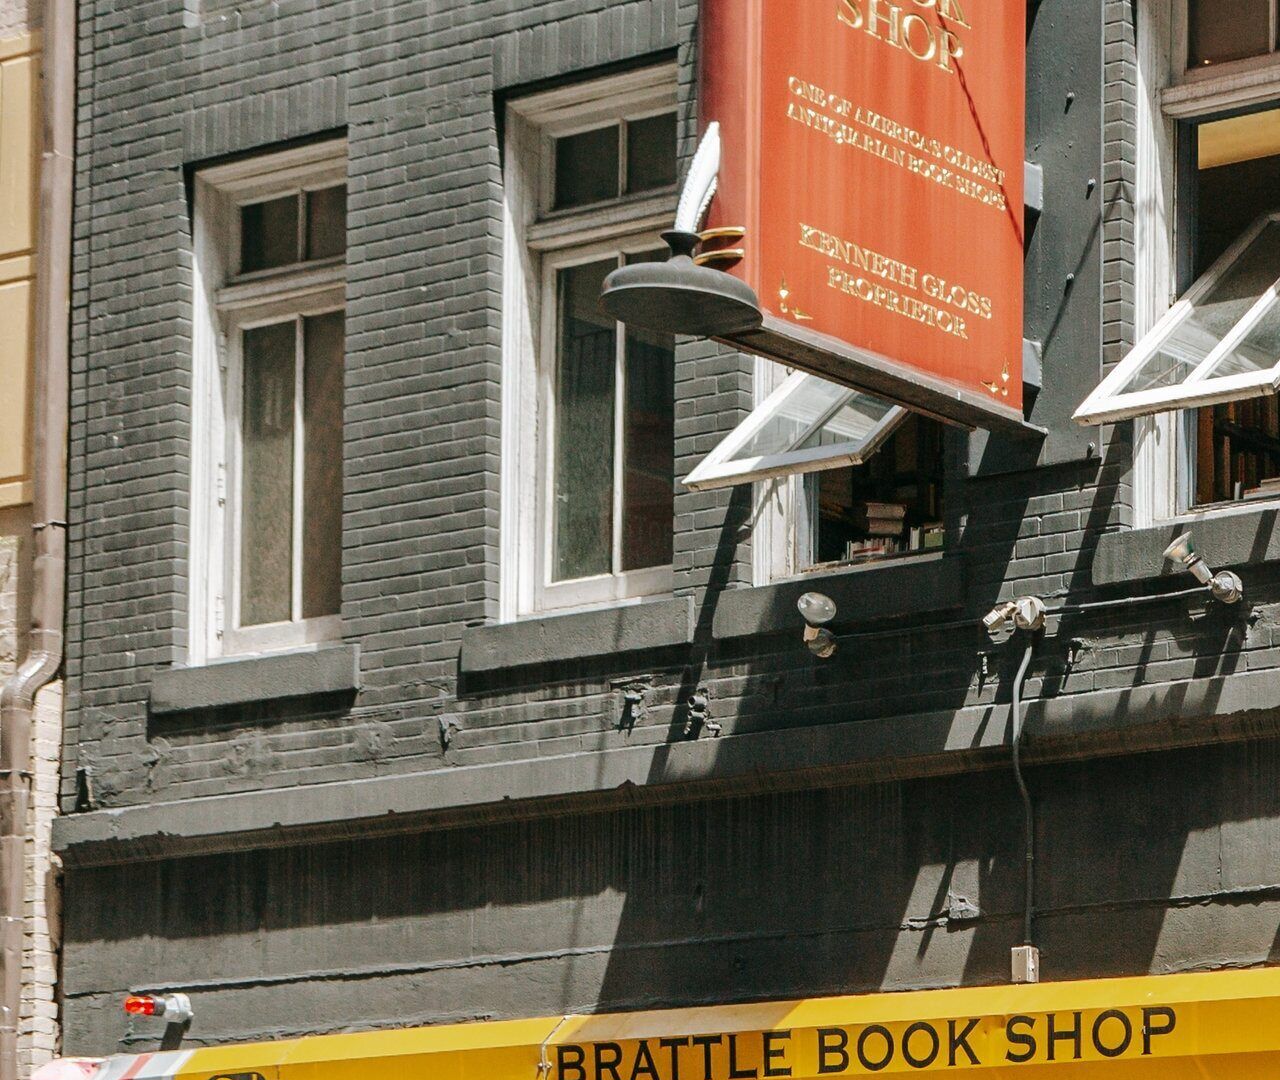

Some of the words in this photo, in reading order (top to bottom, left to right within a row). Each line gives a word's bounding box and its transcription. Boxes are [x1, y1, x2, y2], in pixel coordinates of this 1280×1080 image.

[837, 0, 962, 74] SHOP
[786, 103, 905, 167] ANTIQUARIAN
[908, 154, 953, 188] BOOK
[956, 175, 1006, 211] SHOPS
[788, 76, 826, 107] ONE
[828, 94, 852, 117] OF
[943, 145, 1006, 185] OLDEST
[799, 222, 918, 290] KENNETH
[921, 273, 992, 320] GLOSS
[827, 265, 968, 340] PROPRIETOR
[817, 1018, 982, 1077] BOOK
[1005, 1005, 1177, 1063] SHOP
